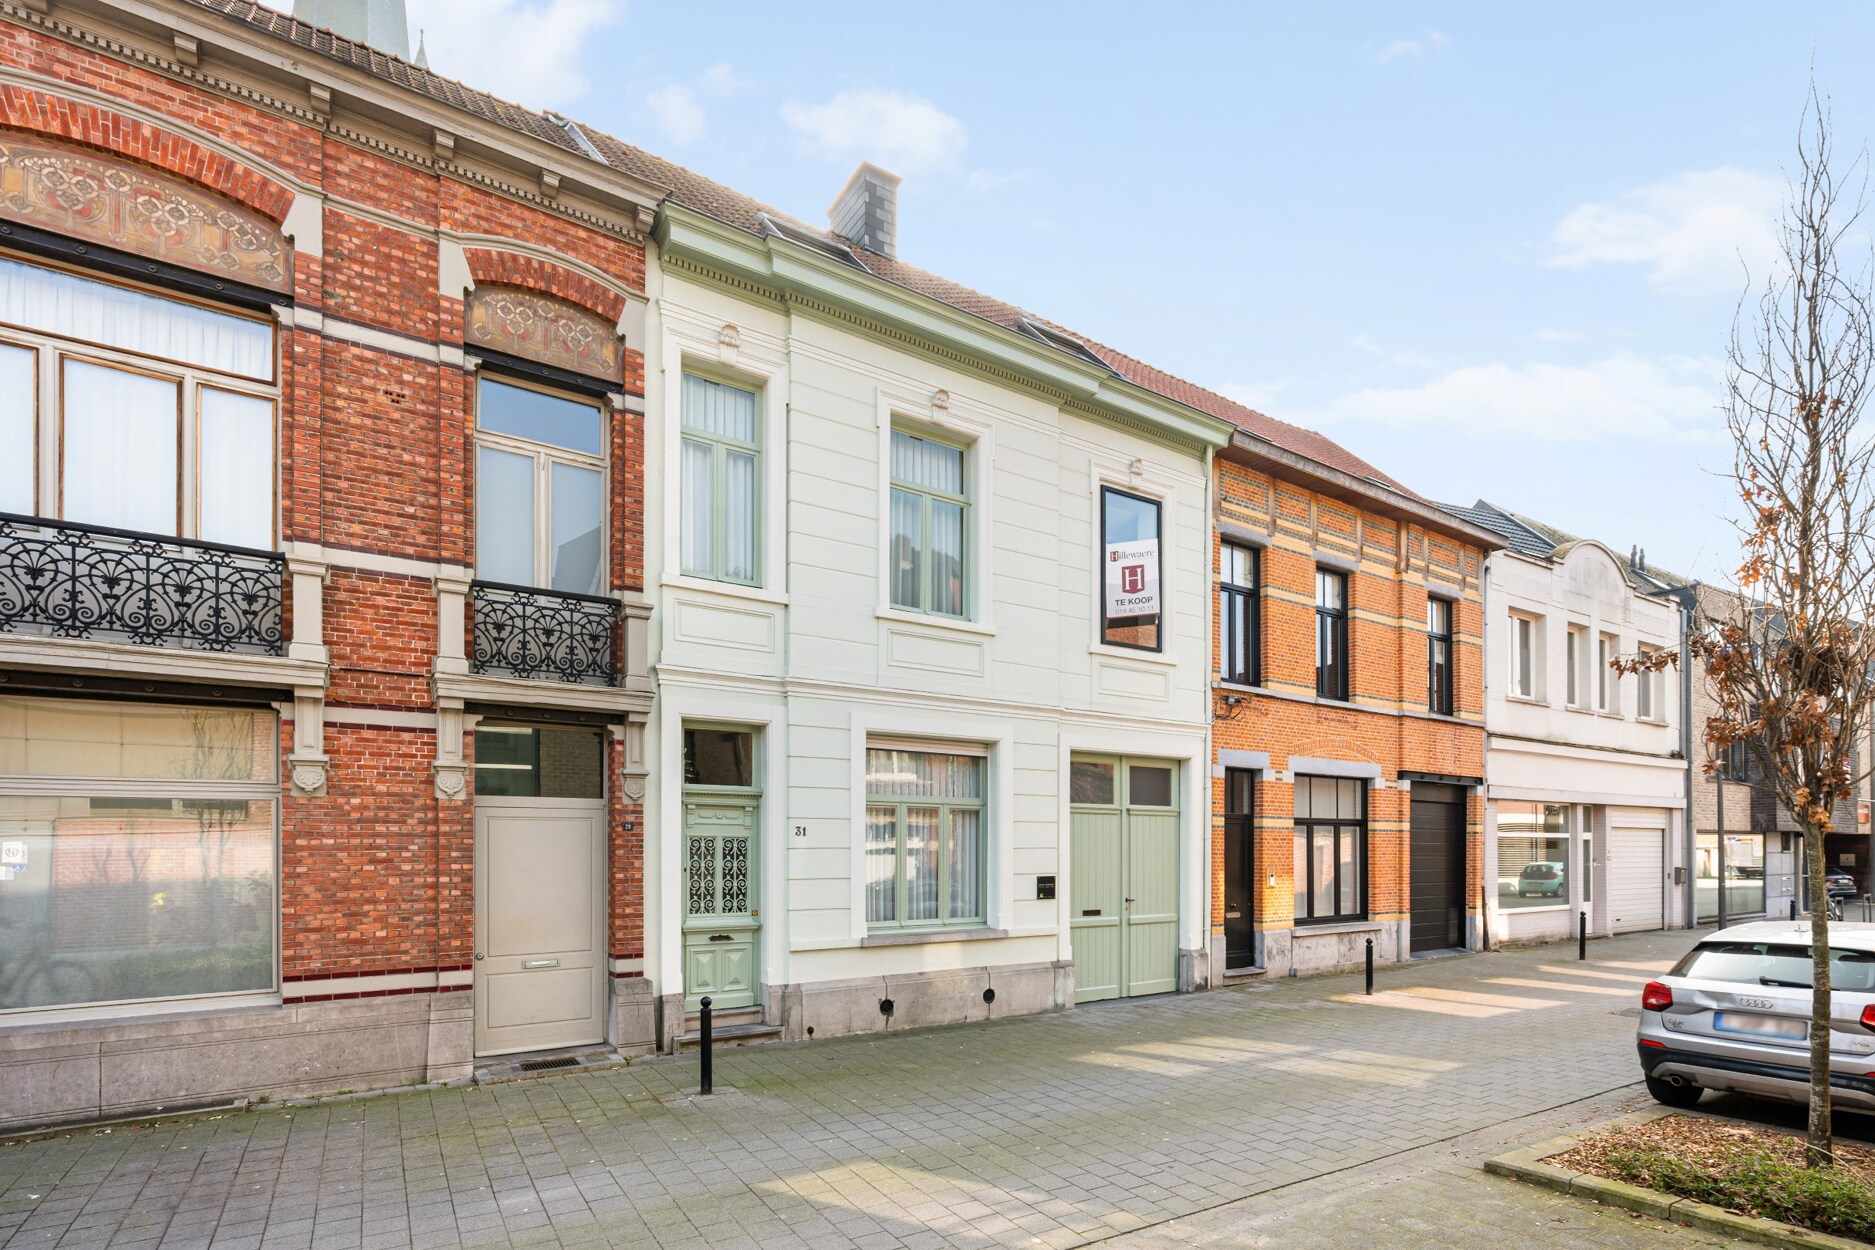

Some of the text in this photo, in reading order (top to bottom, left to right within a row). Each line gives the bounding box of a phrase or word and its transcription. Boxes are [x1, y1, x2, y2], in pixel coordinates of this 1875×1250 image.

[1124, 567, 1143, 591] H
[1128, 596, 1153, 605] KOOP
[795, 826, 806, 836] 31
